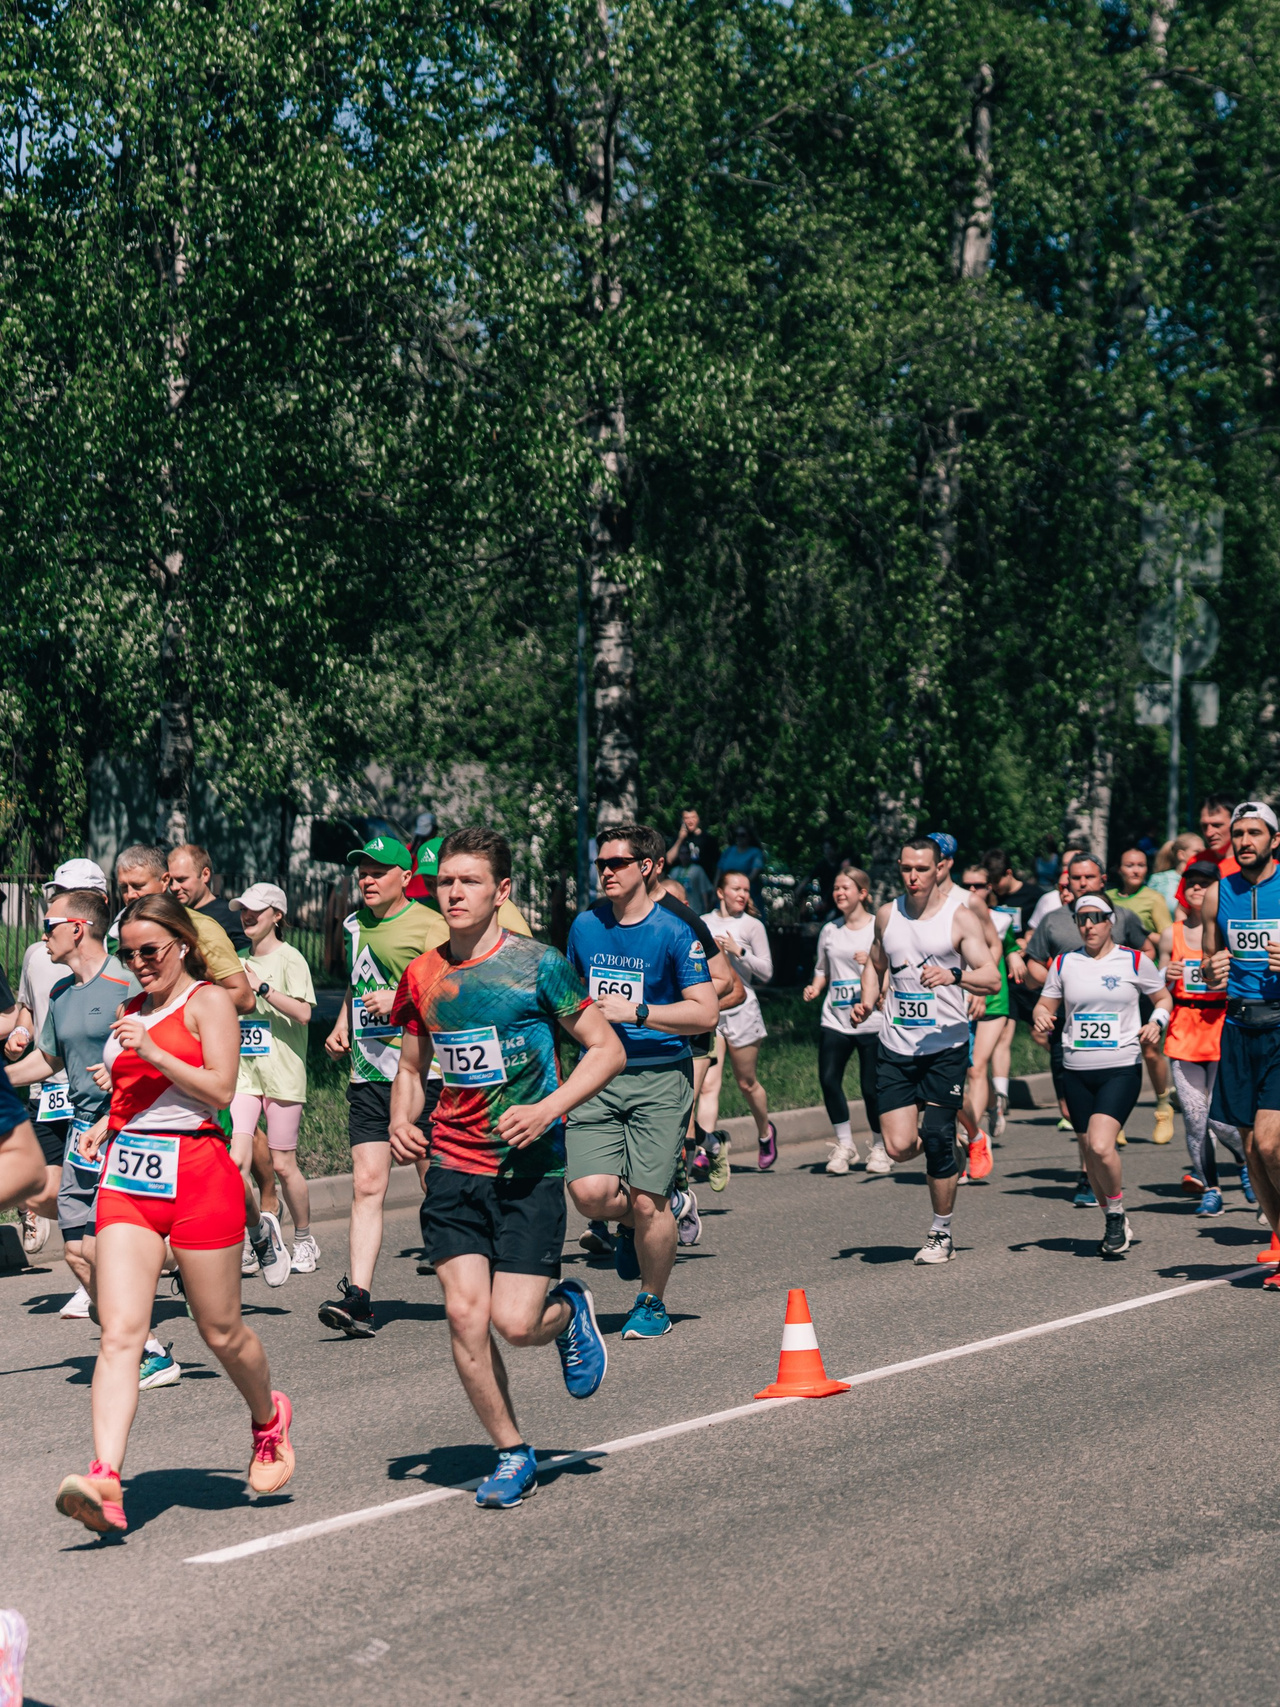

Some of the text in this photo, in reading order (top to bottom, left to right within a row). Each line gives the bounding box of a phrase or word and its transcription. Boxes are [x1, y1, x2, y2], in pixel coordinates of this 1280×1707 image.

[1237, 931, 1270, 950] 890
[593, 953, 644, 970] СУВОРОВ
[598, 980, 633, 1002] 669
[834, 986, 856, 1000] 701
[899, 1001, 928, 1018] 530
[1080, 1022, 1111, 1039] 529
[443, 1045, 489, 1072] 752
[48, 1091, 66, 1110] 85
[118, 1148, 163, 1179] 578
